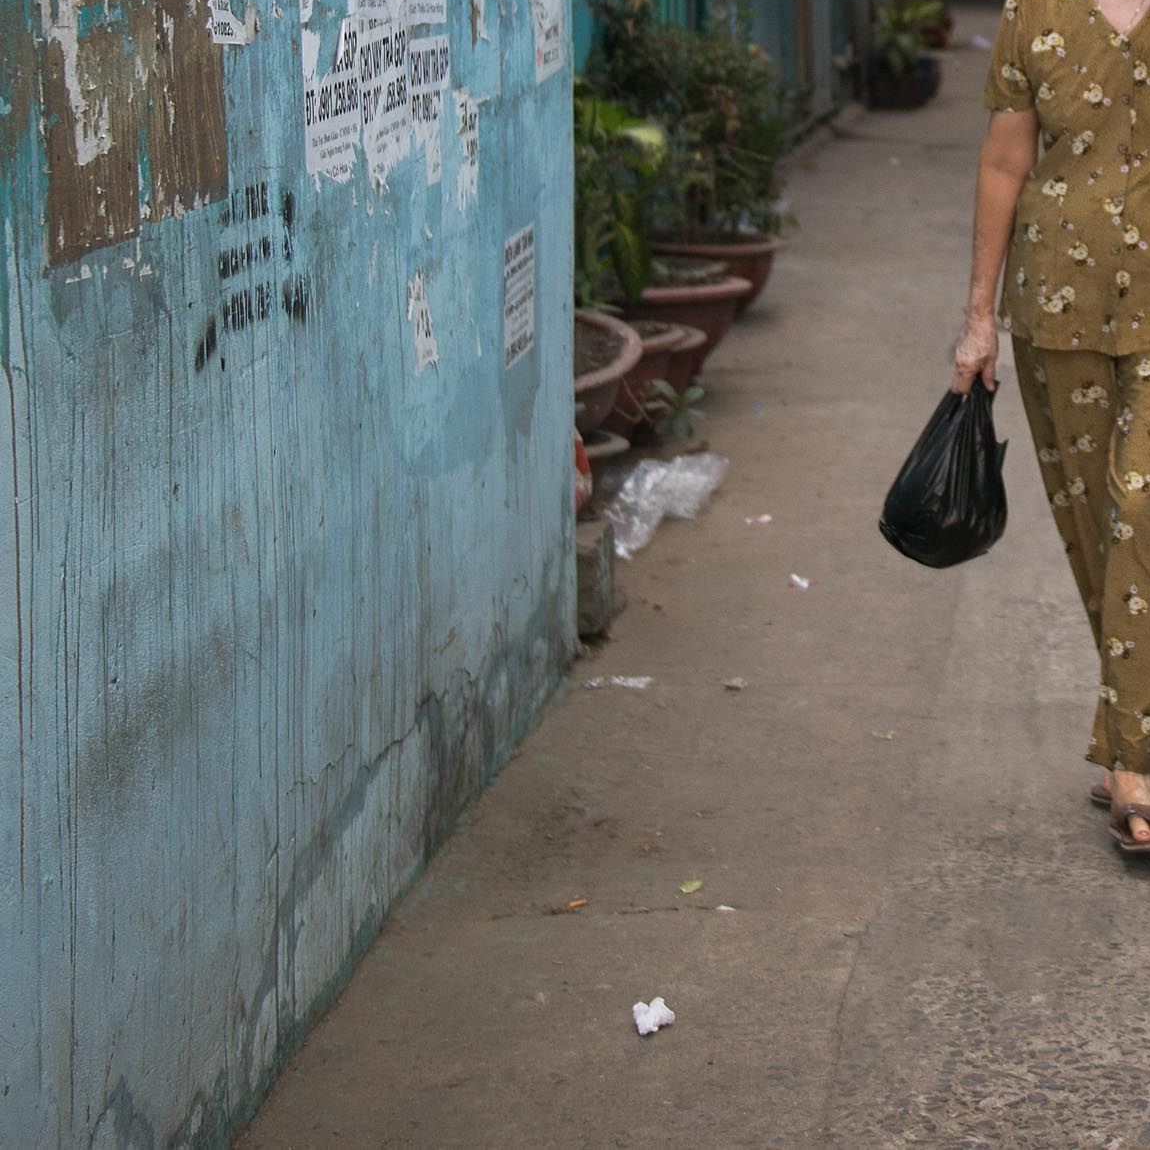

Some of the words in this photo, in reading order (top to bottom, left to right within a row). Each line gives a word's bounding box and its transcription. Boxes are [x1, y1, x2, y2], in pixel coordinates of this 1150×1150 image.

[360, 42, 372, 84] CHO
[411, 50, 422, 88] CHO
[421, 49, 431, 85] VAY
